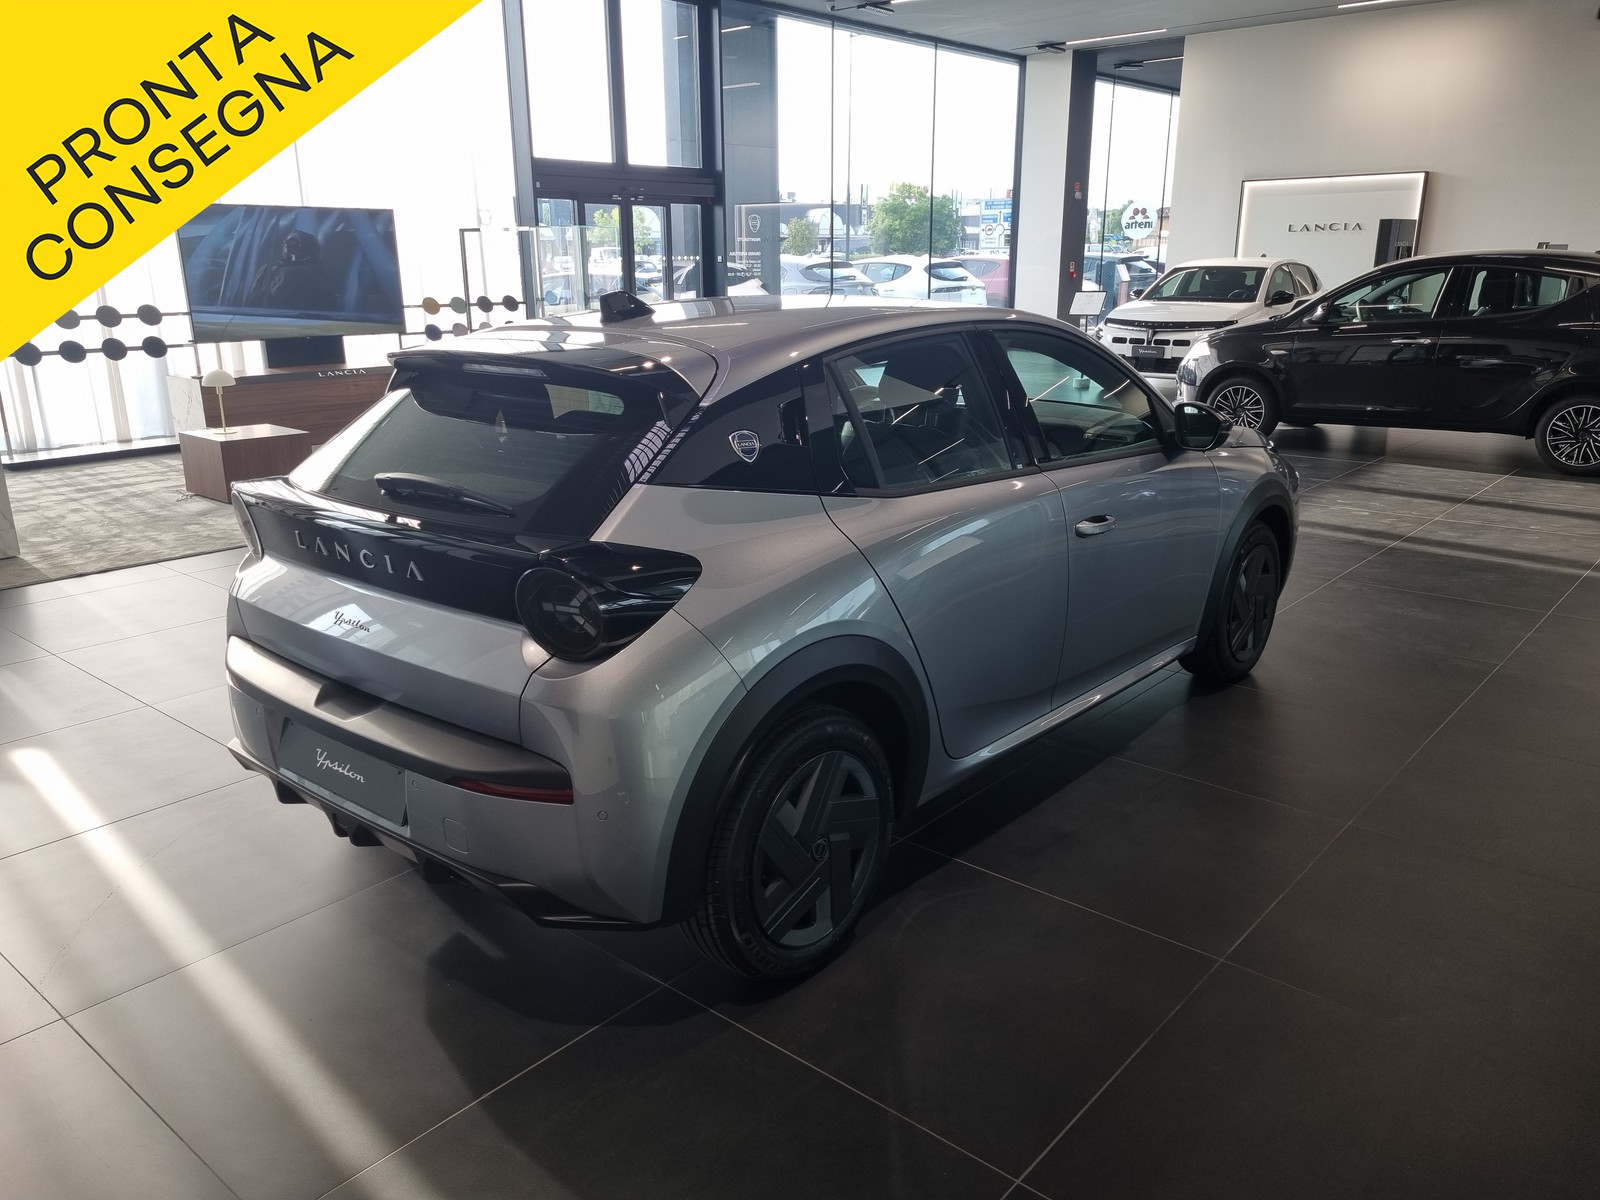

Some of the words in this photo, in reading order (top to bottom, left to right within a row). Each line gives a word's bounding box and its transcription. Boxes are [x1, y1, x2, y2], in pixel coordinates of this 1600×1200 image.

[1124, 220, 1153, 230] arteni
[1287, 222, 1363, 233] LANCIA
[318, 368, 367, 377] LANCIA
[294, 530, 424, 581] LANCIA
[334, 611, 371, 633] Ypsilon
[316, 748, 365, 783] Ypsilon
